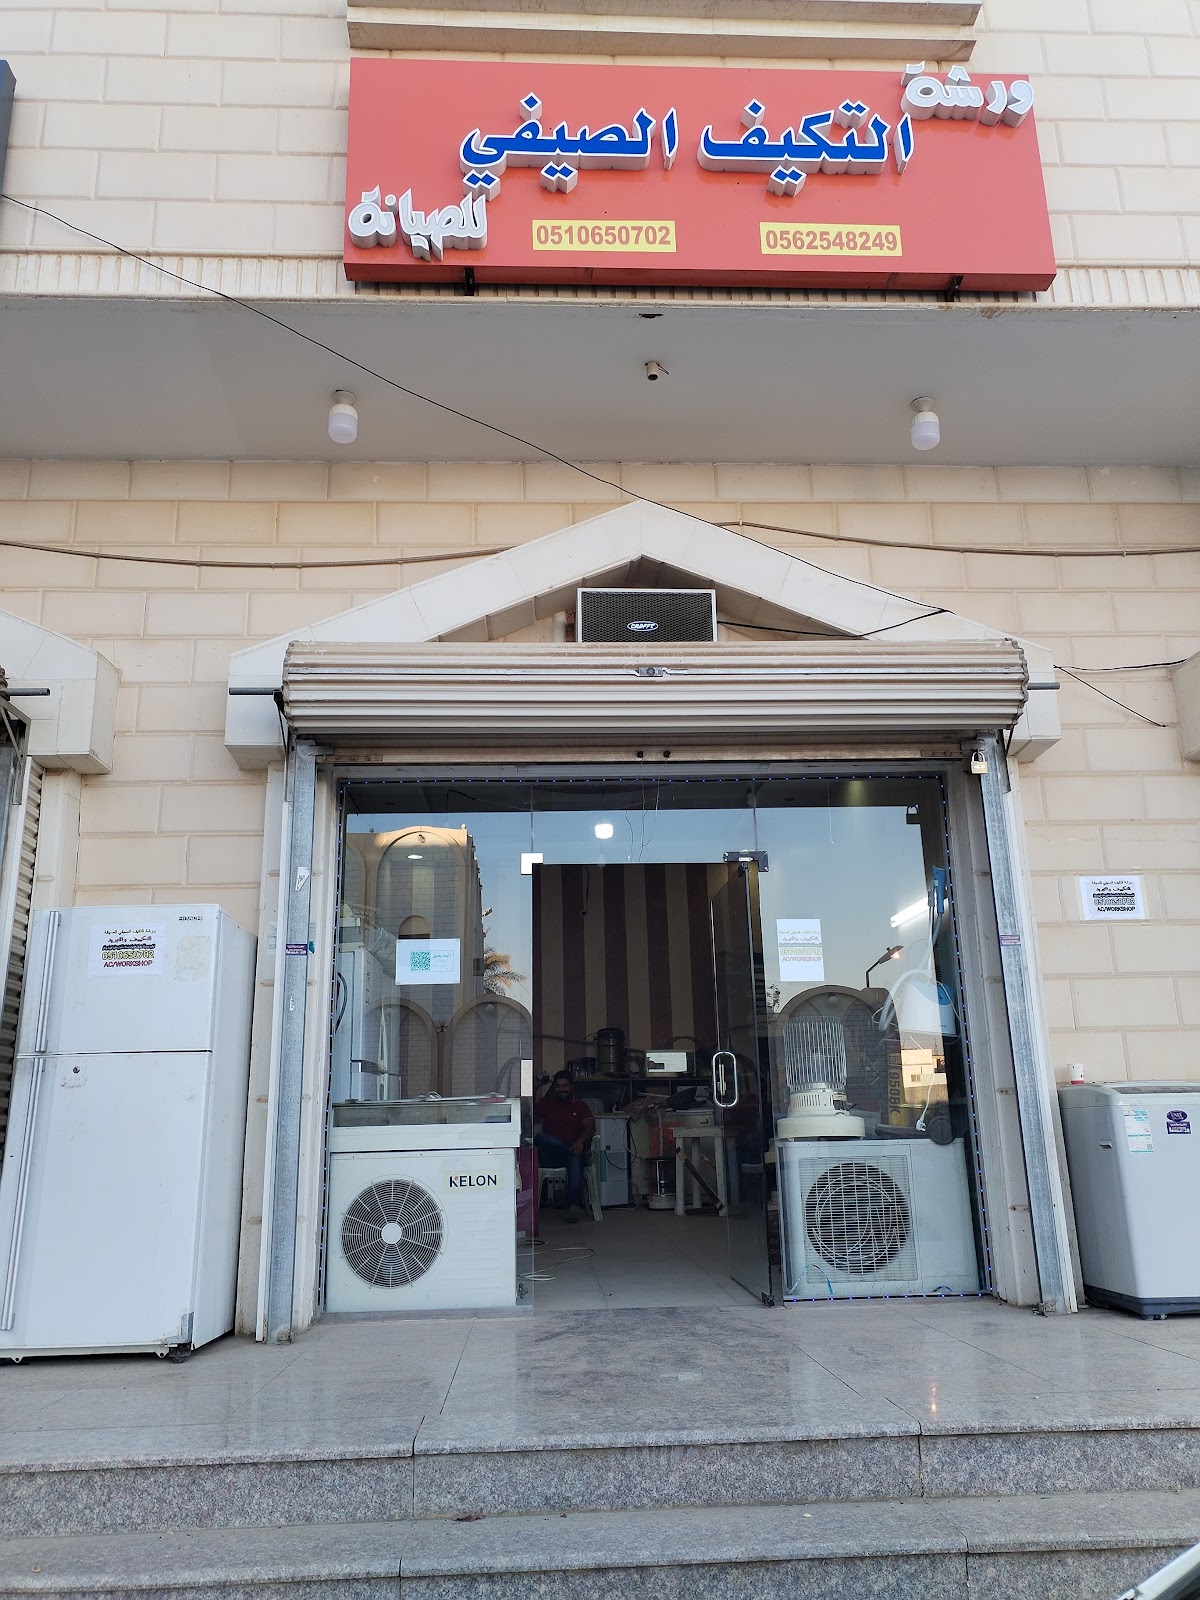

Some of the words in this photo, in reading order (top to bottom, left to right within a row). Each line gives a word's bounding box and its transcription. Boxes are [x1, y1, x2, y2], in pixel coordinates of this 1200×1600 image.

[902, 61, 1035, 125] ورشة
[459, 91, 680, 198] الصيفي
[699, 97, 916, 193] التكيف
[348, 185, 488, 259] للصيانة
[536, 224, 671, 246] 0510650702
[765, 229, 898, 252] 0562548249
[103, 960, 153, 968] AC/WORKSHOP
[449, 1174, 497, 1188] KELON
